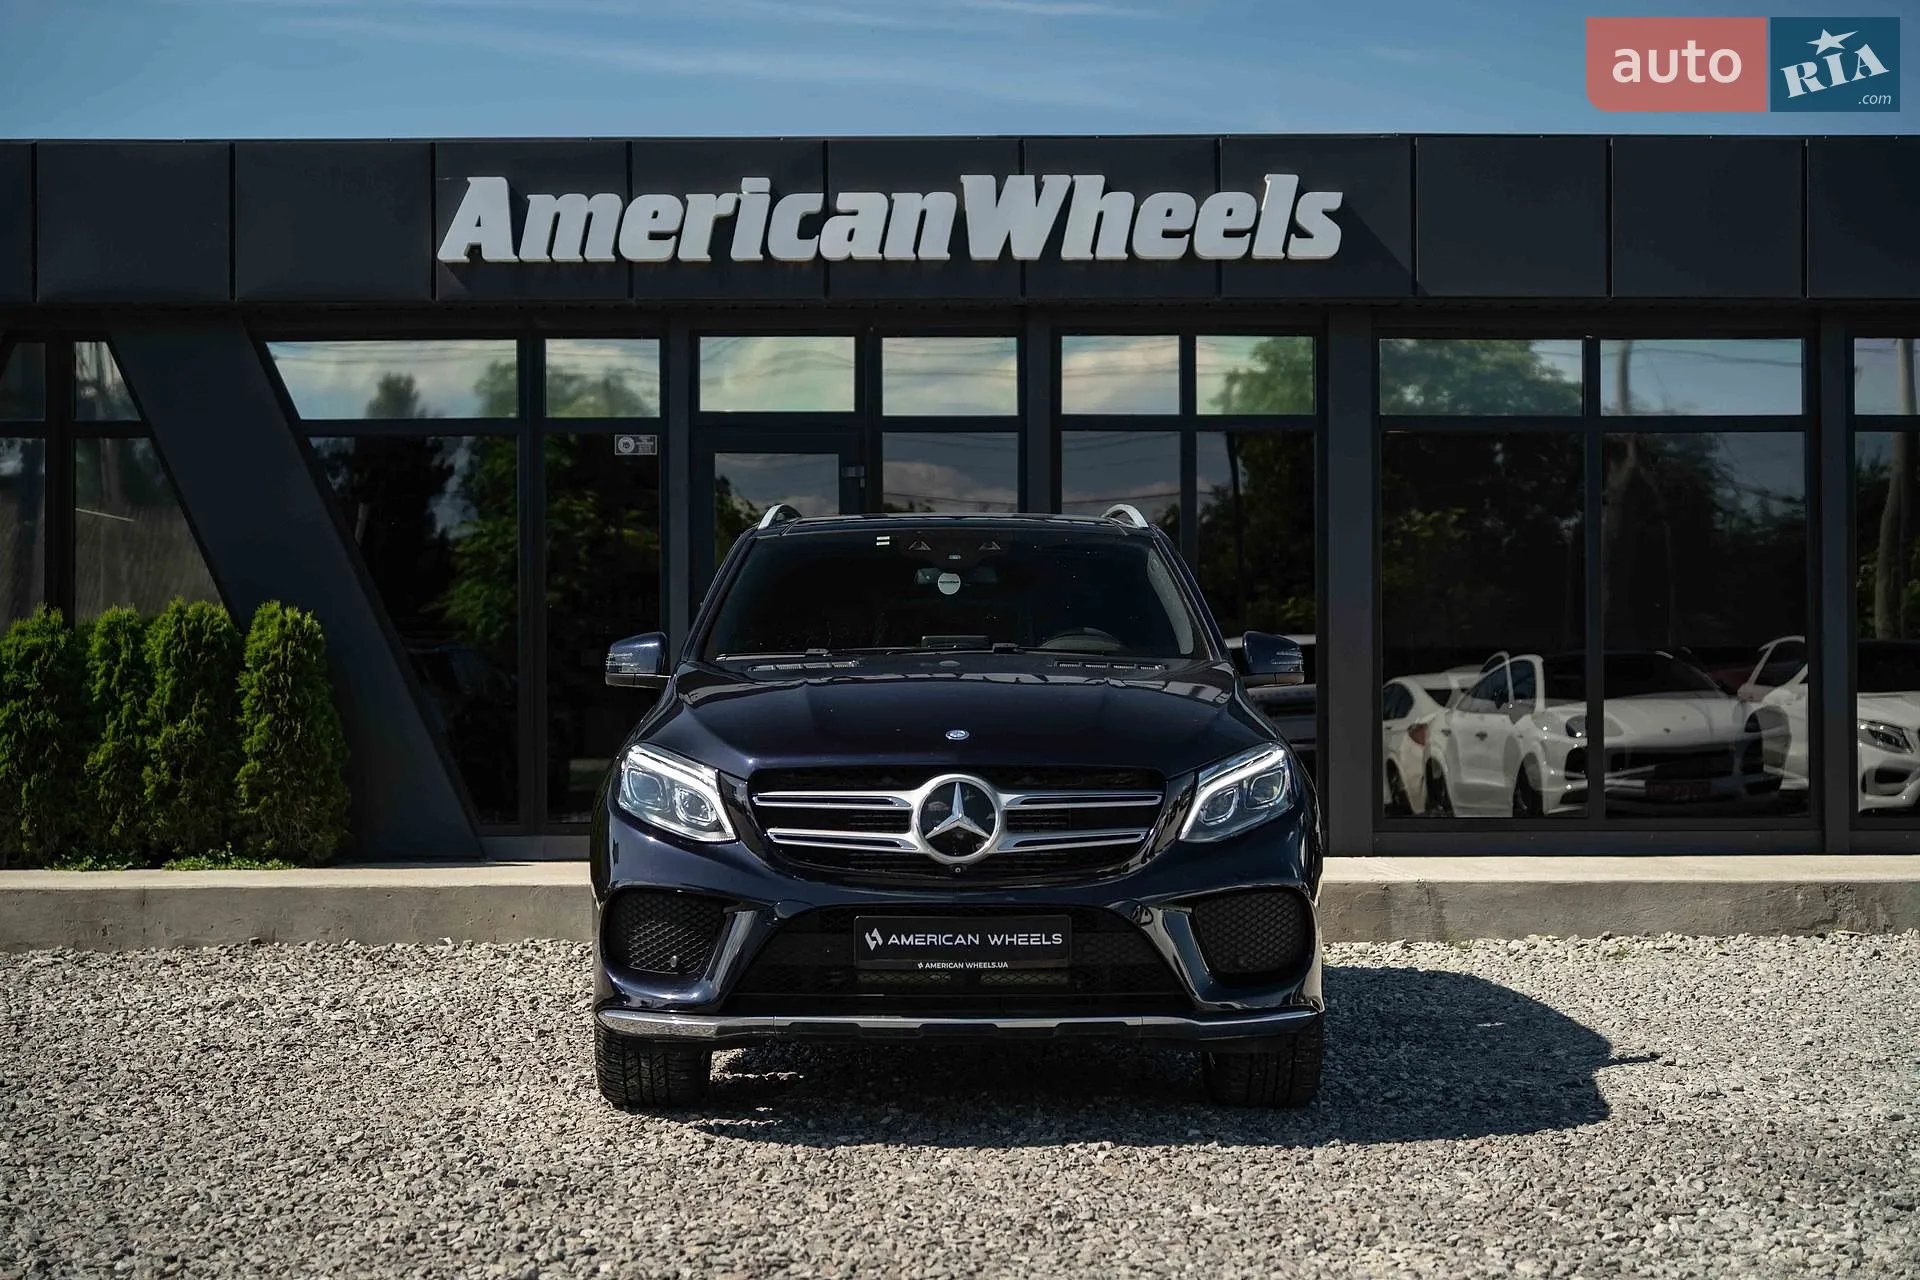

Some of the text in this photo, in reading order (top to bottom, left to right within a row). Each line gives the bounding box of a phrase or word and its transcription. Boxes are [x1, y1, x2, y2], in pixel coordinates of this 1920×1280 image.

[436, 173, 1344, 263] AmericanWheels
[887, 933, 1063, 946] AMERICAN WHEELS
